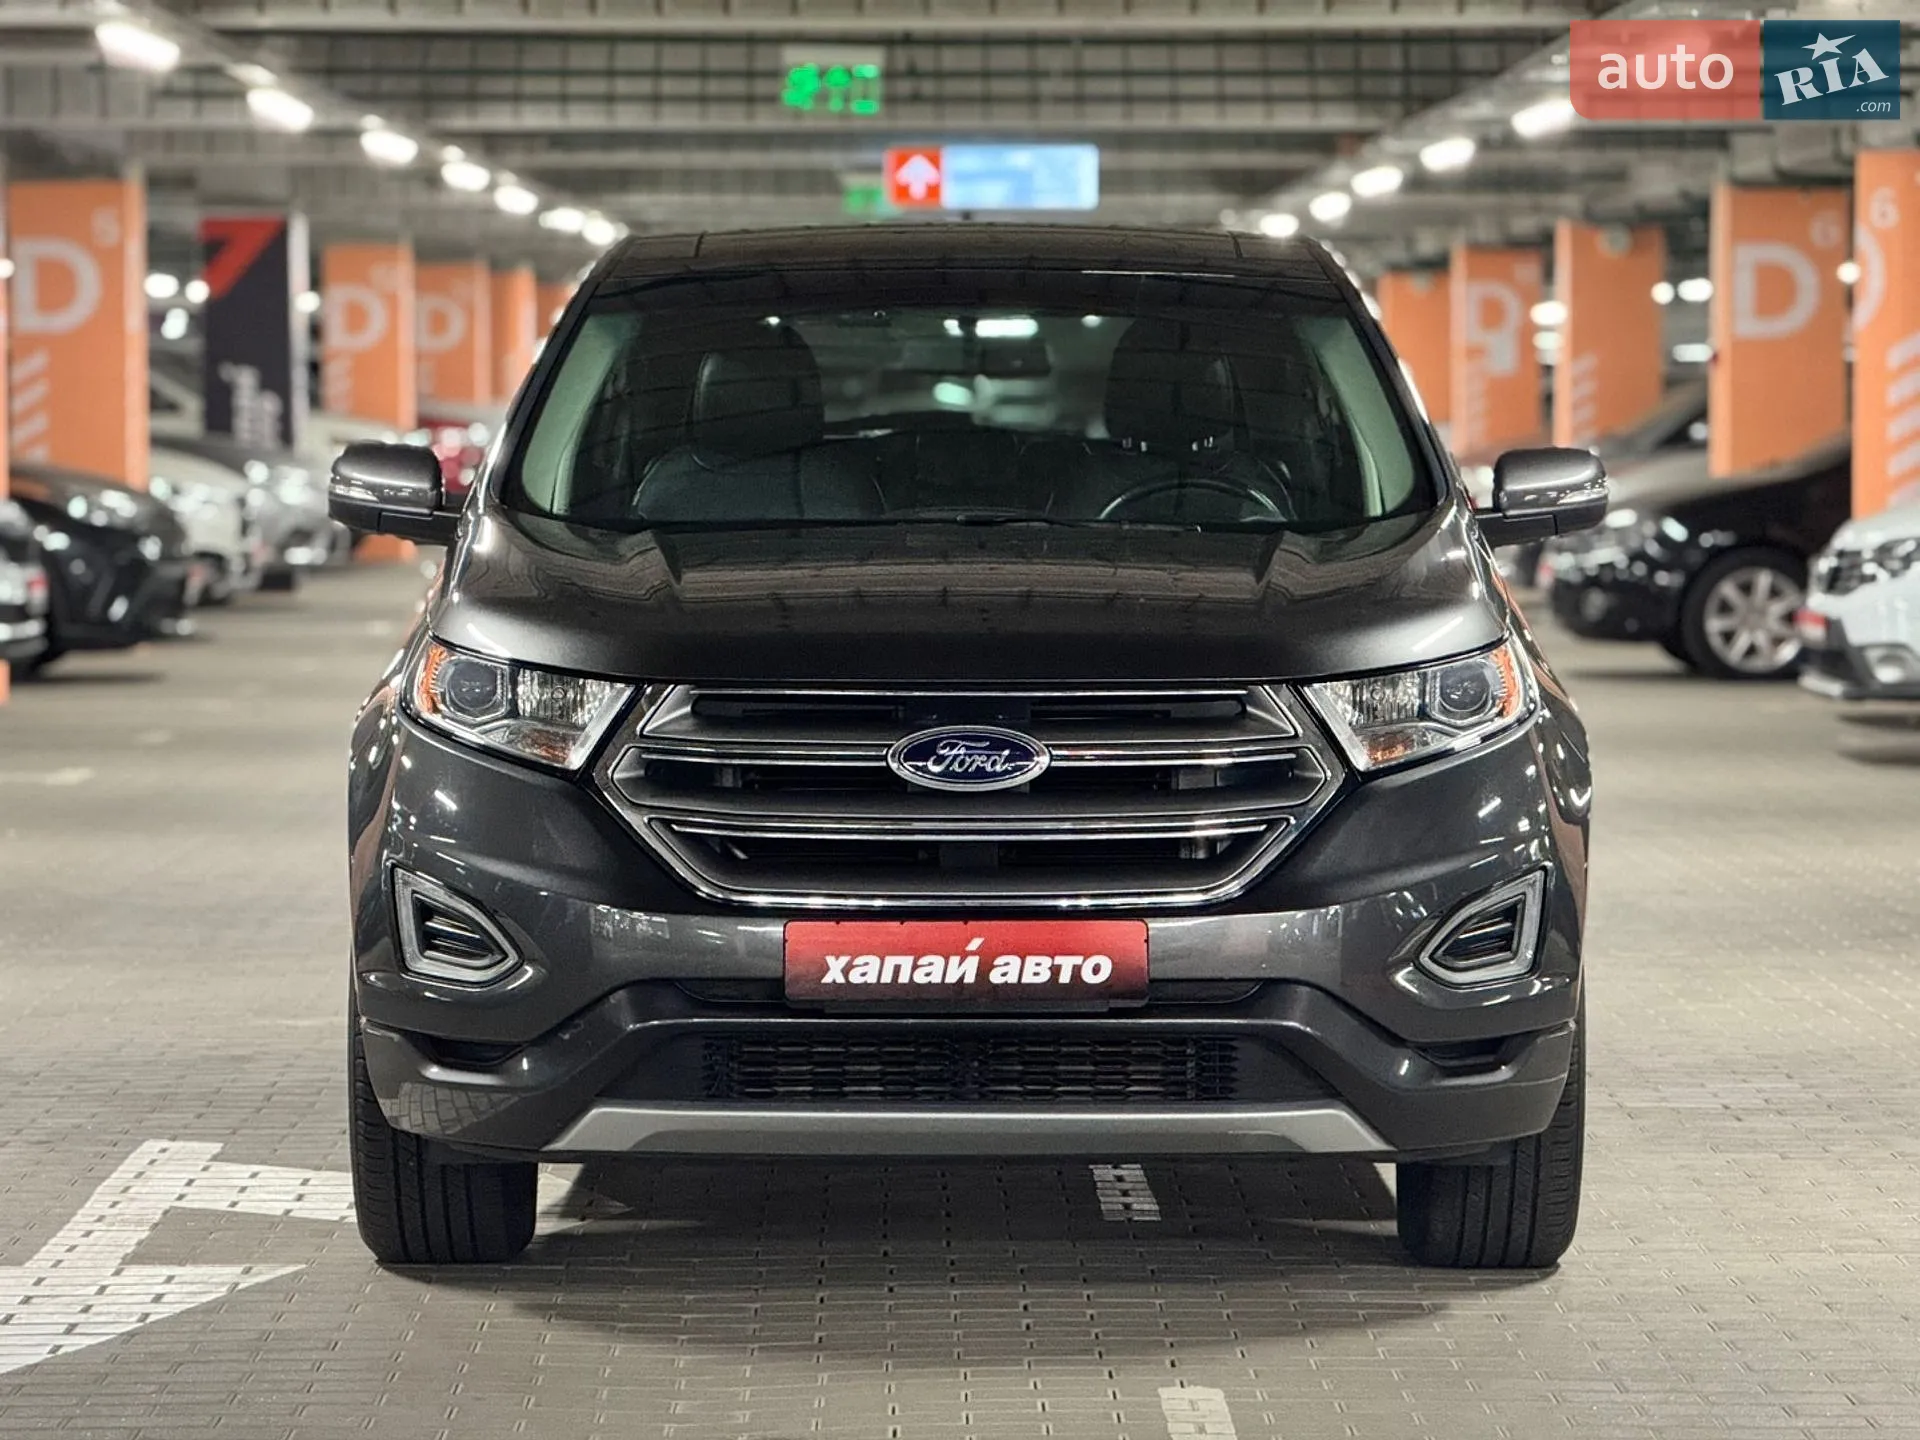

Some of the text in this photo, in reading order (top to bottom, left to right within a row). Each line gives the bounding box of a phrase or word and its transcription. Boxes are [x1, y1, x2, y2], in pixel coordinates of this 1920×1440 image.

[13, 237, 102, 334] D
[1734, 241, 1822, 339] D
[927, 739, 1012, 773] Ford
[988, 955, 1114, 984] авто
